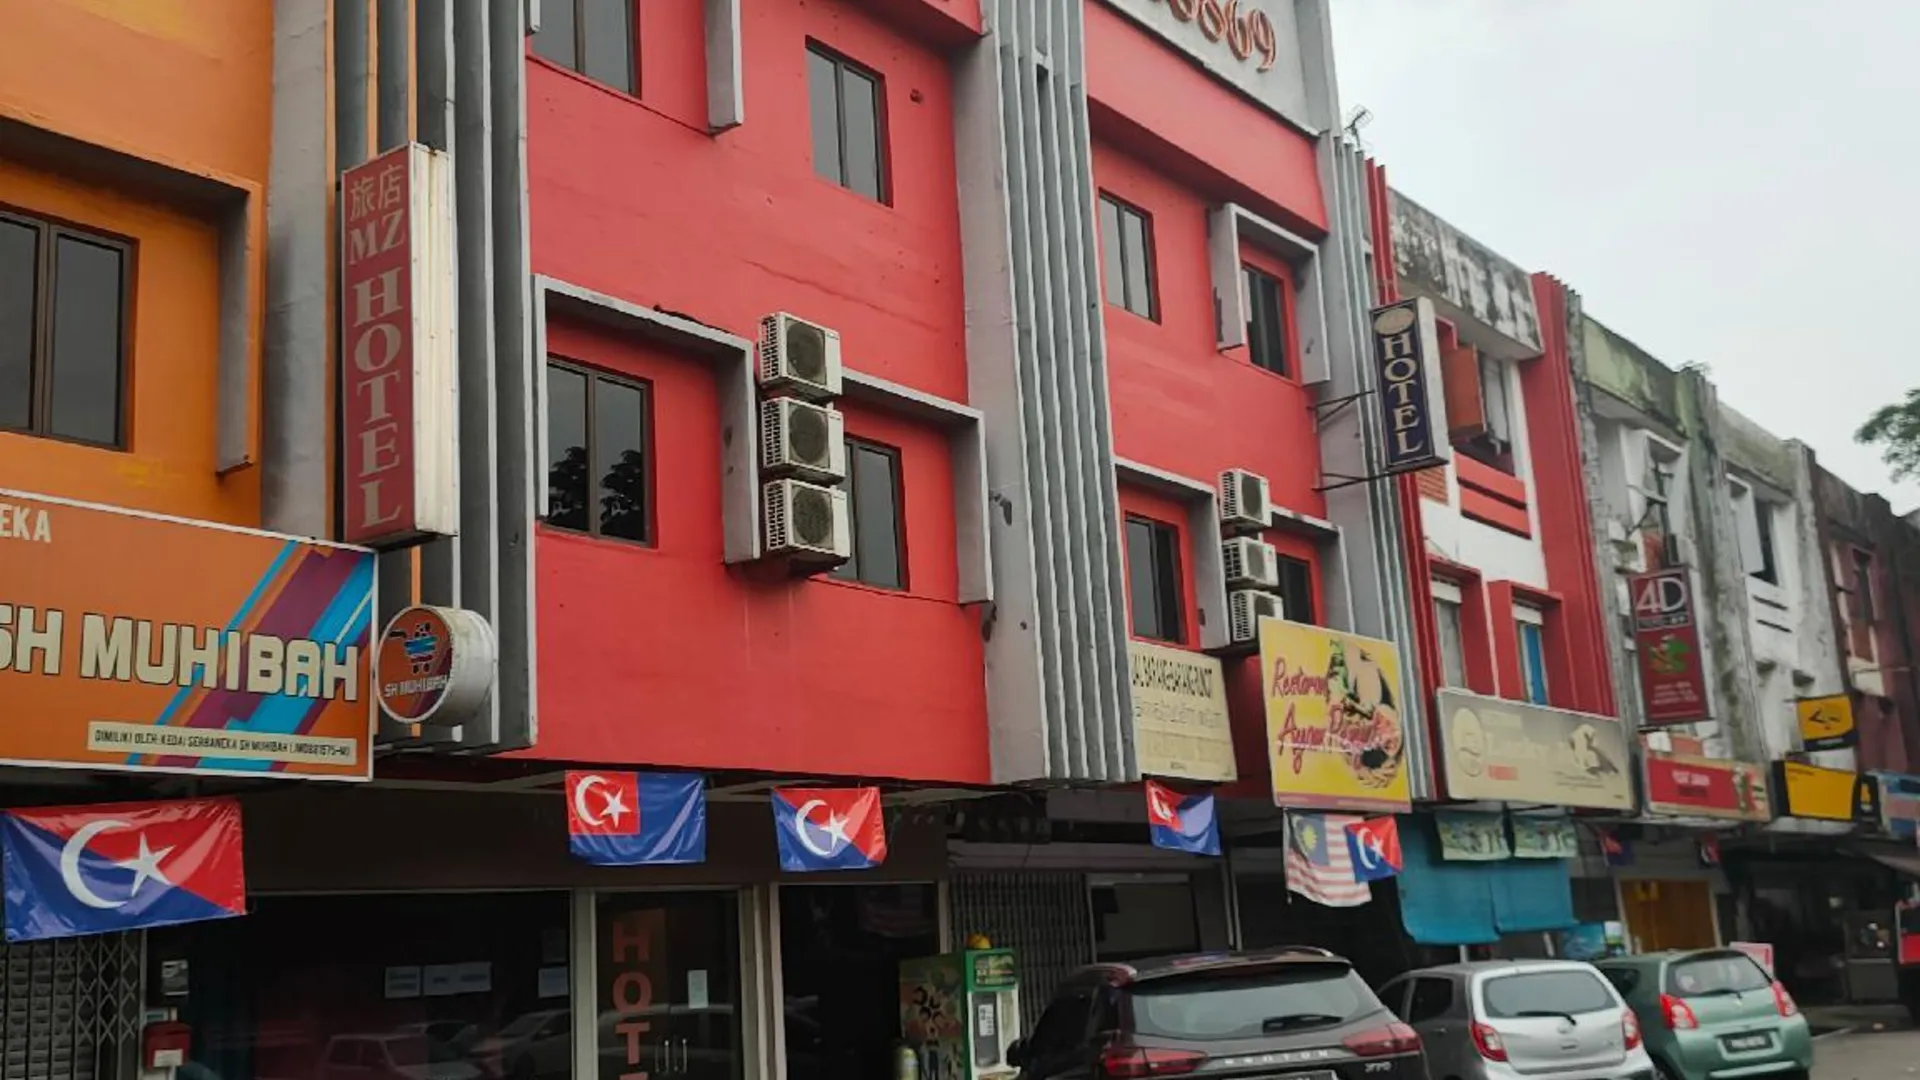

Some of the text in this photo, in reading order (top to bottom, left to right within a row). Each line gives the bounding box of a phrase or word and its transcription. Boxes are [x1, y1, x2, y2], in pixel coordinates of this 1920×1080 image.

[350, 164, 404, 222] 旅店
[349, 209, 407, 266] MZ
[352, 267, 403, 529] HOTEL
[1380, 332, 1424, 456] HOTEL
[1636, 577, 1687, 613] 4D
[79, 612, 360, 702] MUHIBAH
[613, 921, 652, 1080] HOT
[1224, 1049, 1329, 1065] OTON
